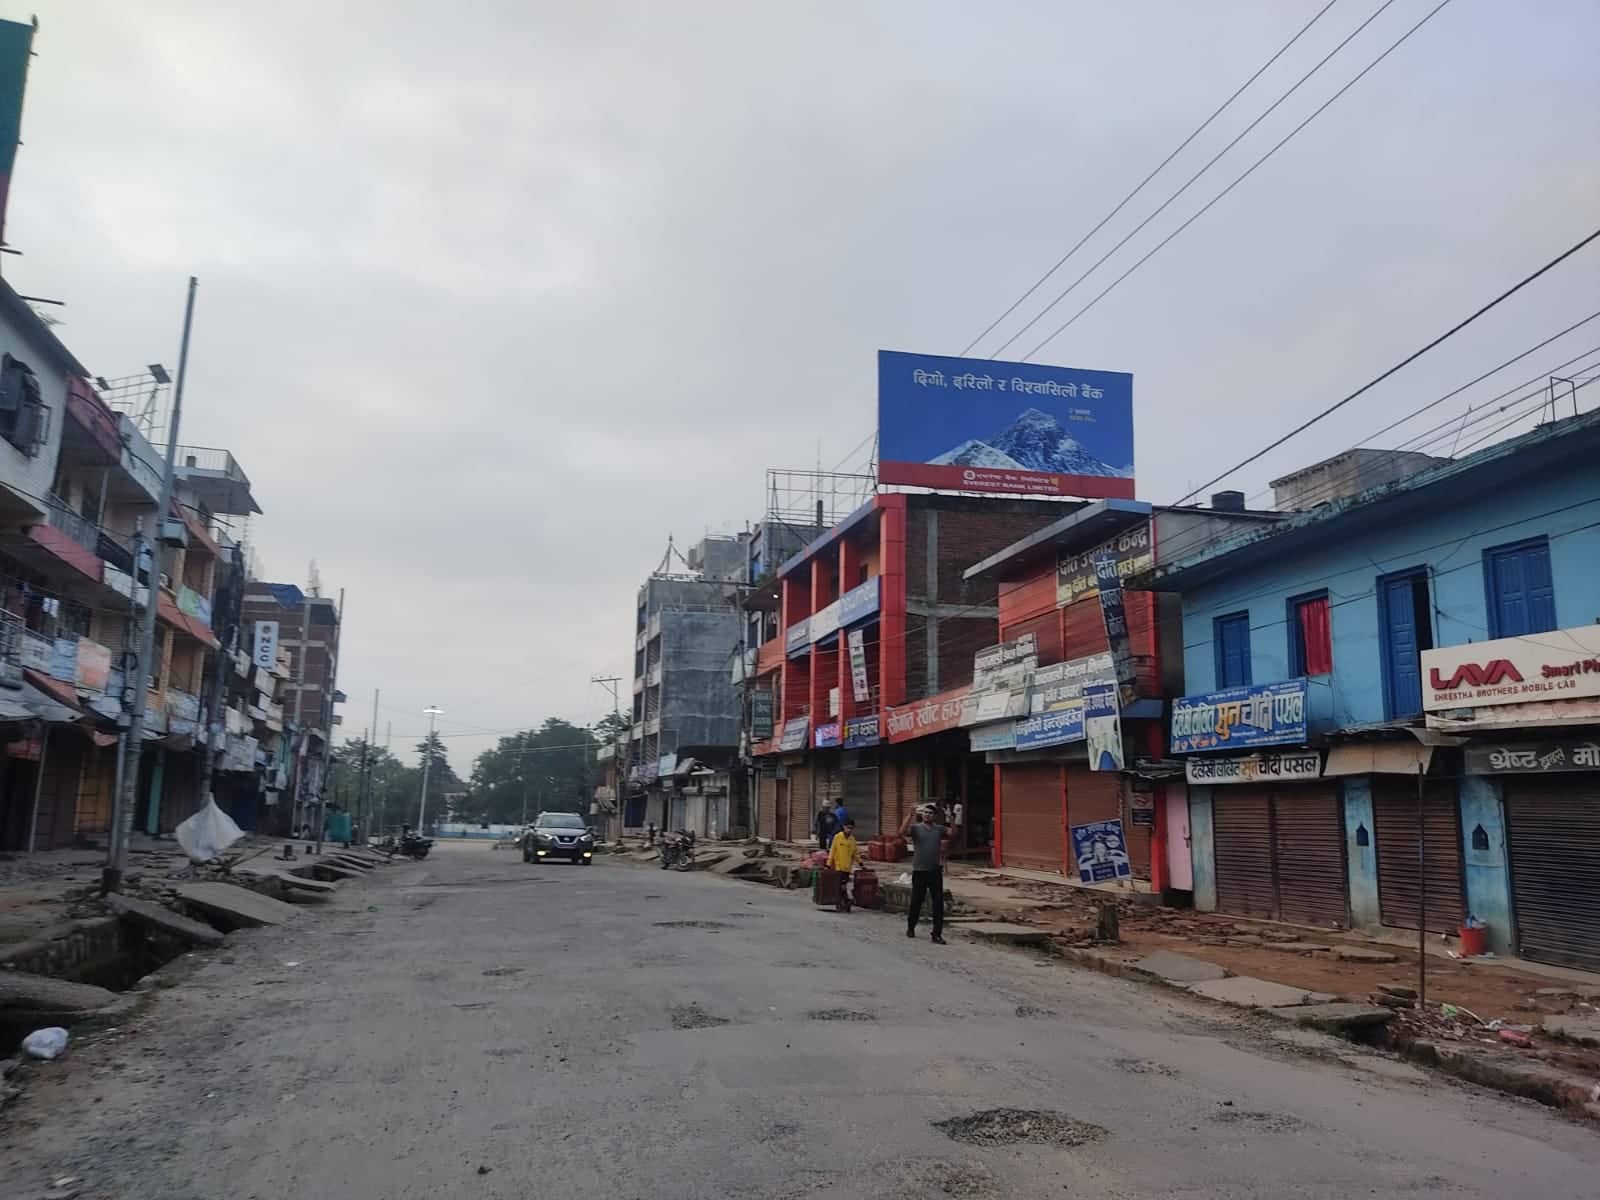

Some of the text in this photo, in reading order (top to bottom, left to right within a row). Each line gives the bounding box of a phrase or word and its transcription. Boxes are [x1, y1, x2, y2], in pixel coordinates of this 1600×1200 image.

[998, 380, 1009, 391] र
[1081, 383, 1104, 400] बैंक
[1430, 659, 1600, 690] LAVA Smart Ph
[1476, 685, 1519, 698] BROTHERS
[1522, 681, 1553, 693] MOBILE
[1557, 679, 1577, 690] LAB
